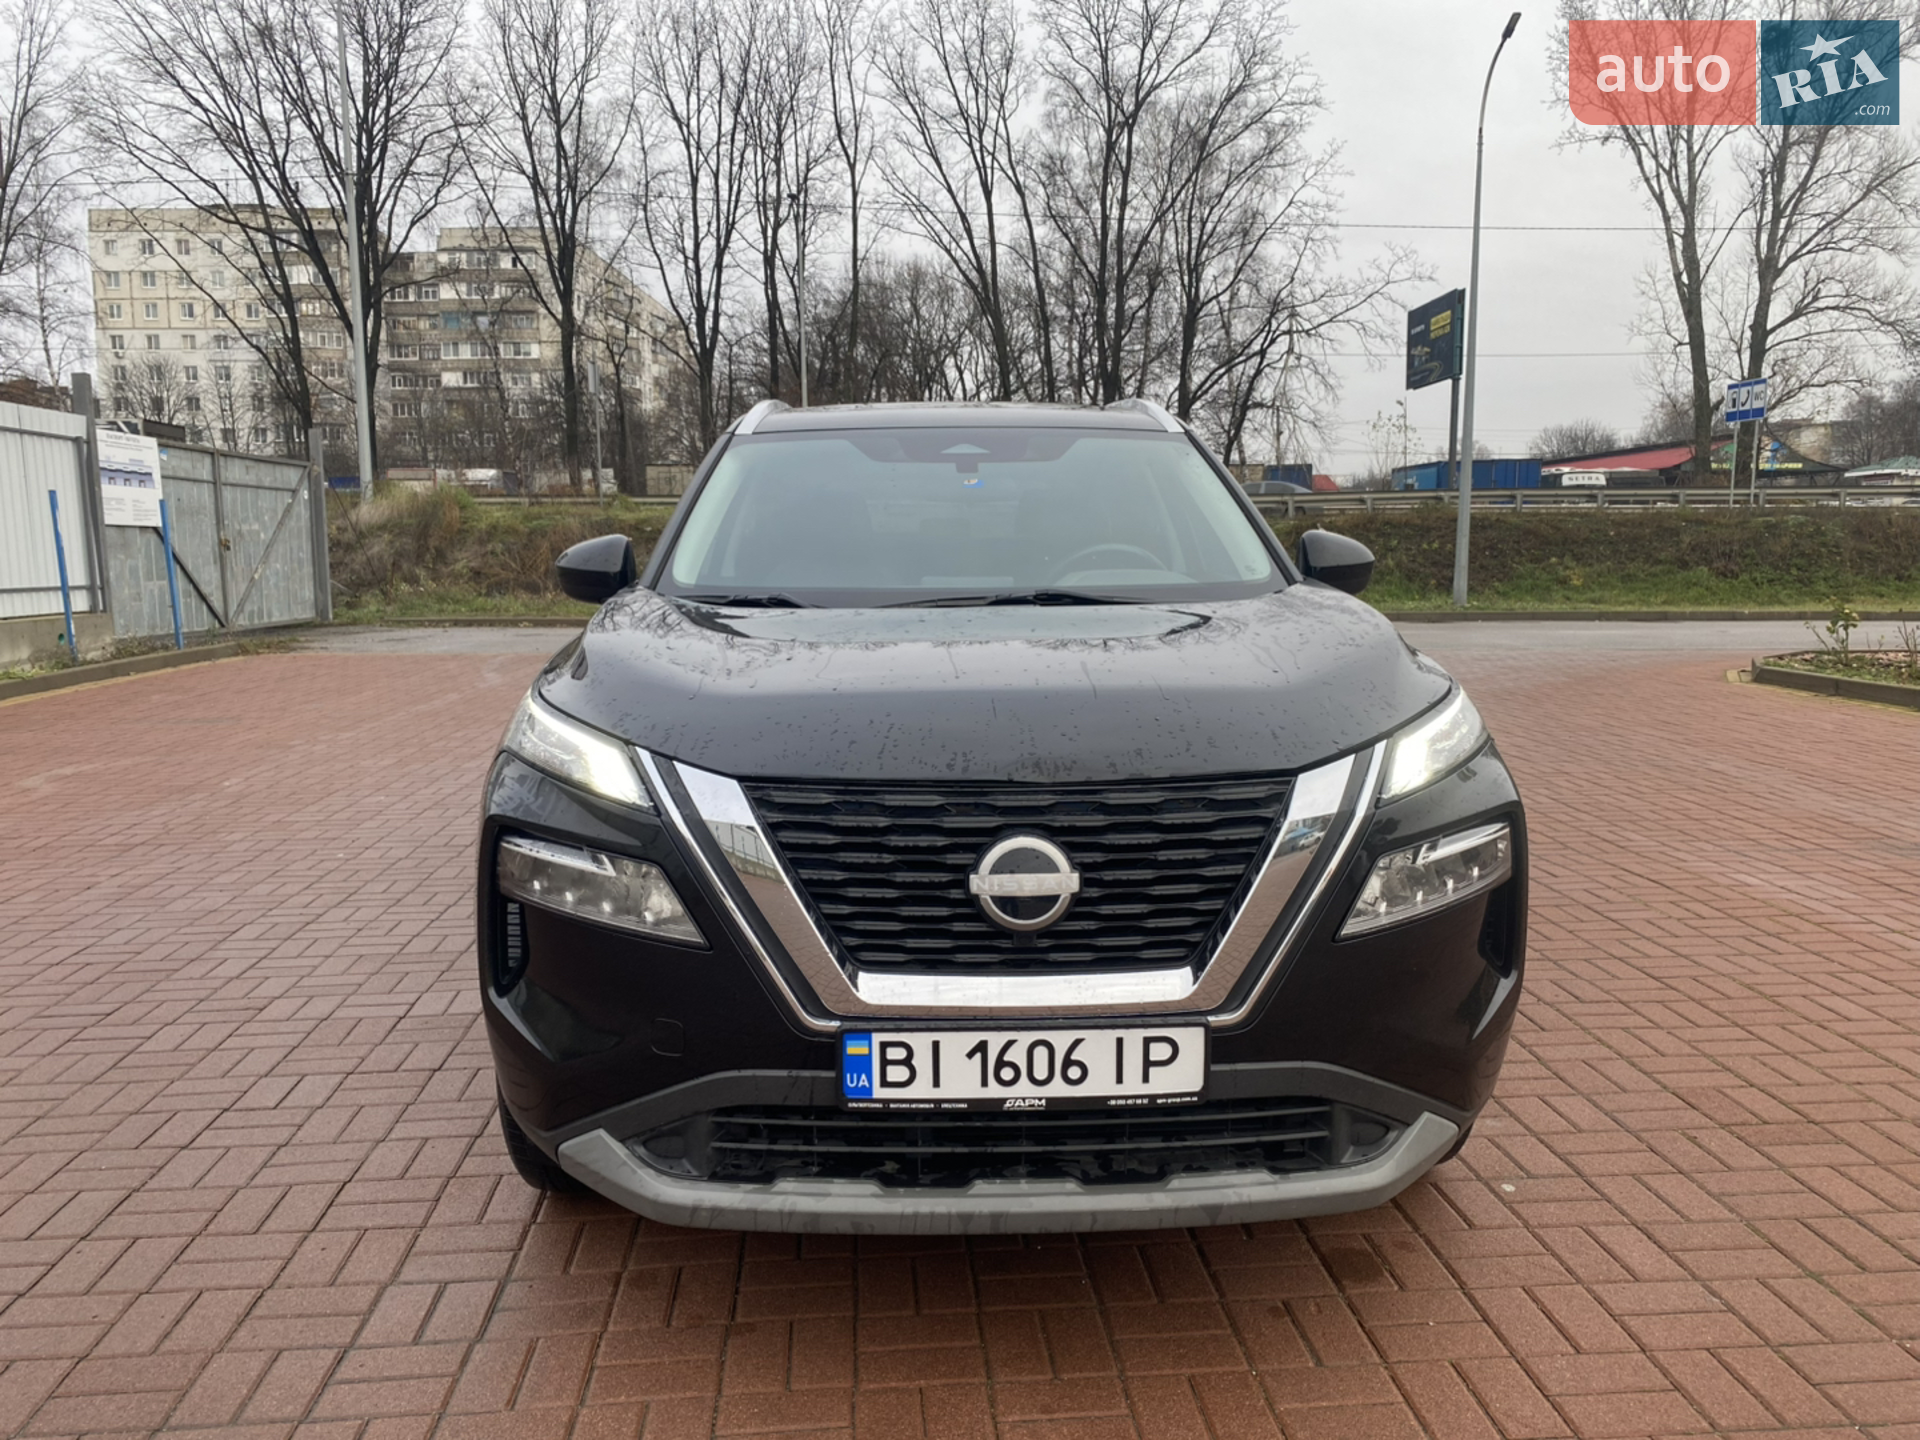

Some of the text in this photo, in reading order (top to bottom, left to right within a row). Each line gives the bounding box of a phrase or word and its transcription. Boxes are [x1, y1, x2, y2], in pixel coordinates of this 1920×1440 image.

[1754, 390, 1765, 402] WC
[972, 876, 1077, 892] NISSAN
[878, 1035, 1180, 1089] BI 1606 IP
[846, 1073, 869, 1088] UA
